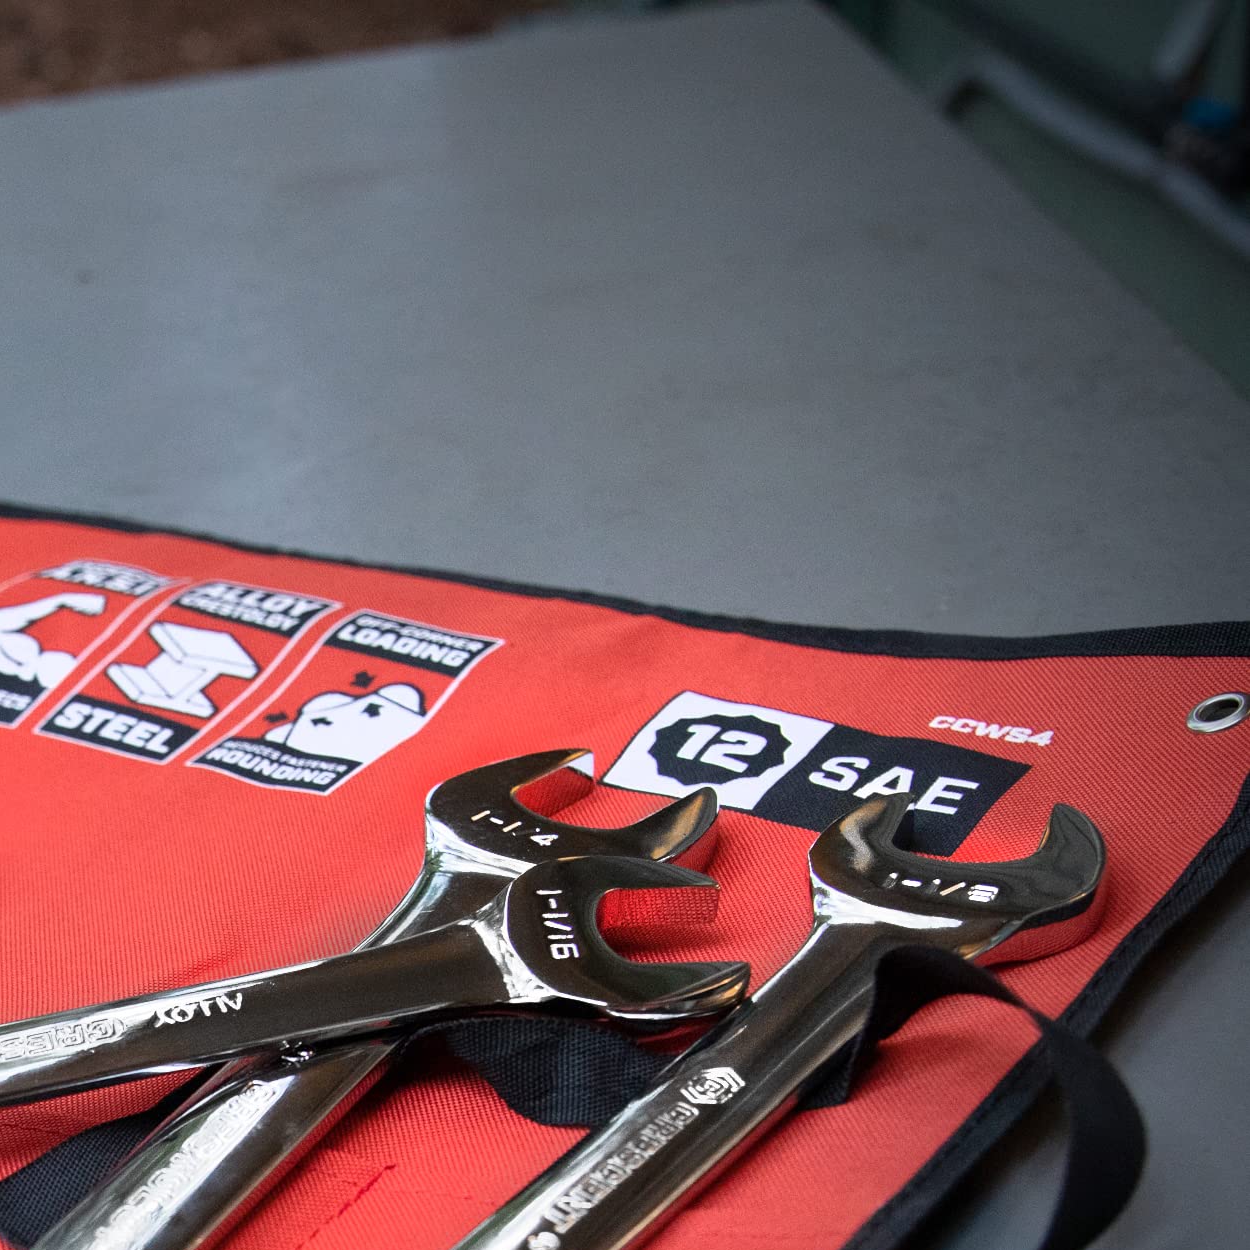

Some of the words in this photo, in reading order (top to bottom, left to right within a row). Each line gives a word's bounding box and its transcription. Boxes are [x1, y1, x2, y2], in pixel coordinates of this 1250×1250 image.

[198, 582, 319, 617] ALLOY
[336, 624, 471, 668] LOADING
[53, 701, 175, 755] STEEL
[928, 714, 1054, 747] CCWS4
[205, 748, 337, 786] ROUNDING
[675, 723, 768, 774] 12
[808, 755, 981, 816] SAE
[535, 888, 580, 960] 1-1/16
[152, 991, 244, 1029] ALLOY
[541, 1101, 700, 1235] CRESCENT
